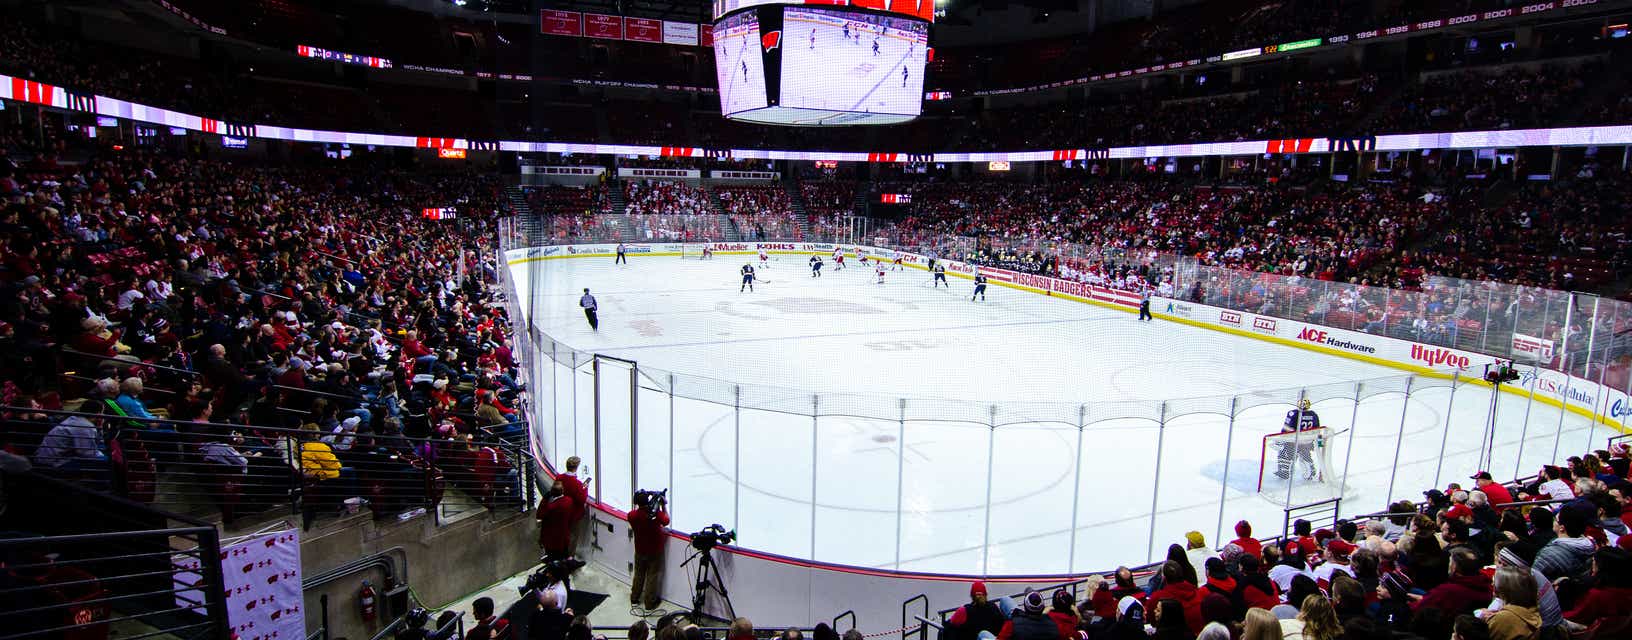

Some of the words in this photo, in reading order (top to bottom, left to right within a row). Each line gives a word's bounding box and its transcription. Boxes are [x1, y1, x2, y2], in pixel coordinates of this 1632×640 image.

[1328, 34, 1348, 43] 1993
[1356, 30, 1377, 39] 1994
[1385, 25, 1408, 35] 1995
[1416, 20, 1441, 30] 1998
[1448, 14, 1477, 25] 2000
[1484, 9, 1512, 20] 2001
[1521, 2, 1553, 14] 2004
[719, 243, 749, 251] Mueller
[1011, 271, 1051, 292] WISCONSIN
[1053, 279, 1093, 298] BADGERS
[1296, 325, 1328, 343] ACE
[1326, 337, 1376, 354] Hardware
